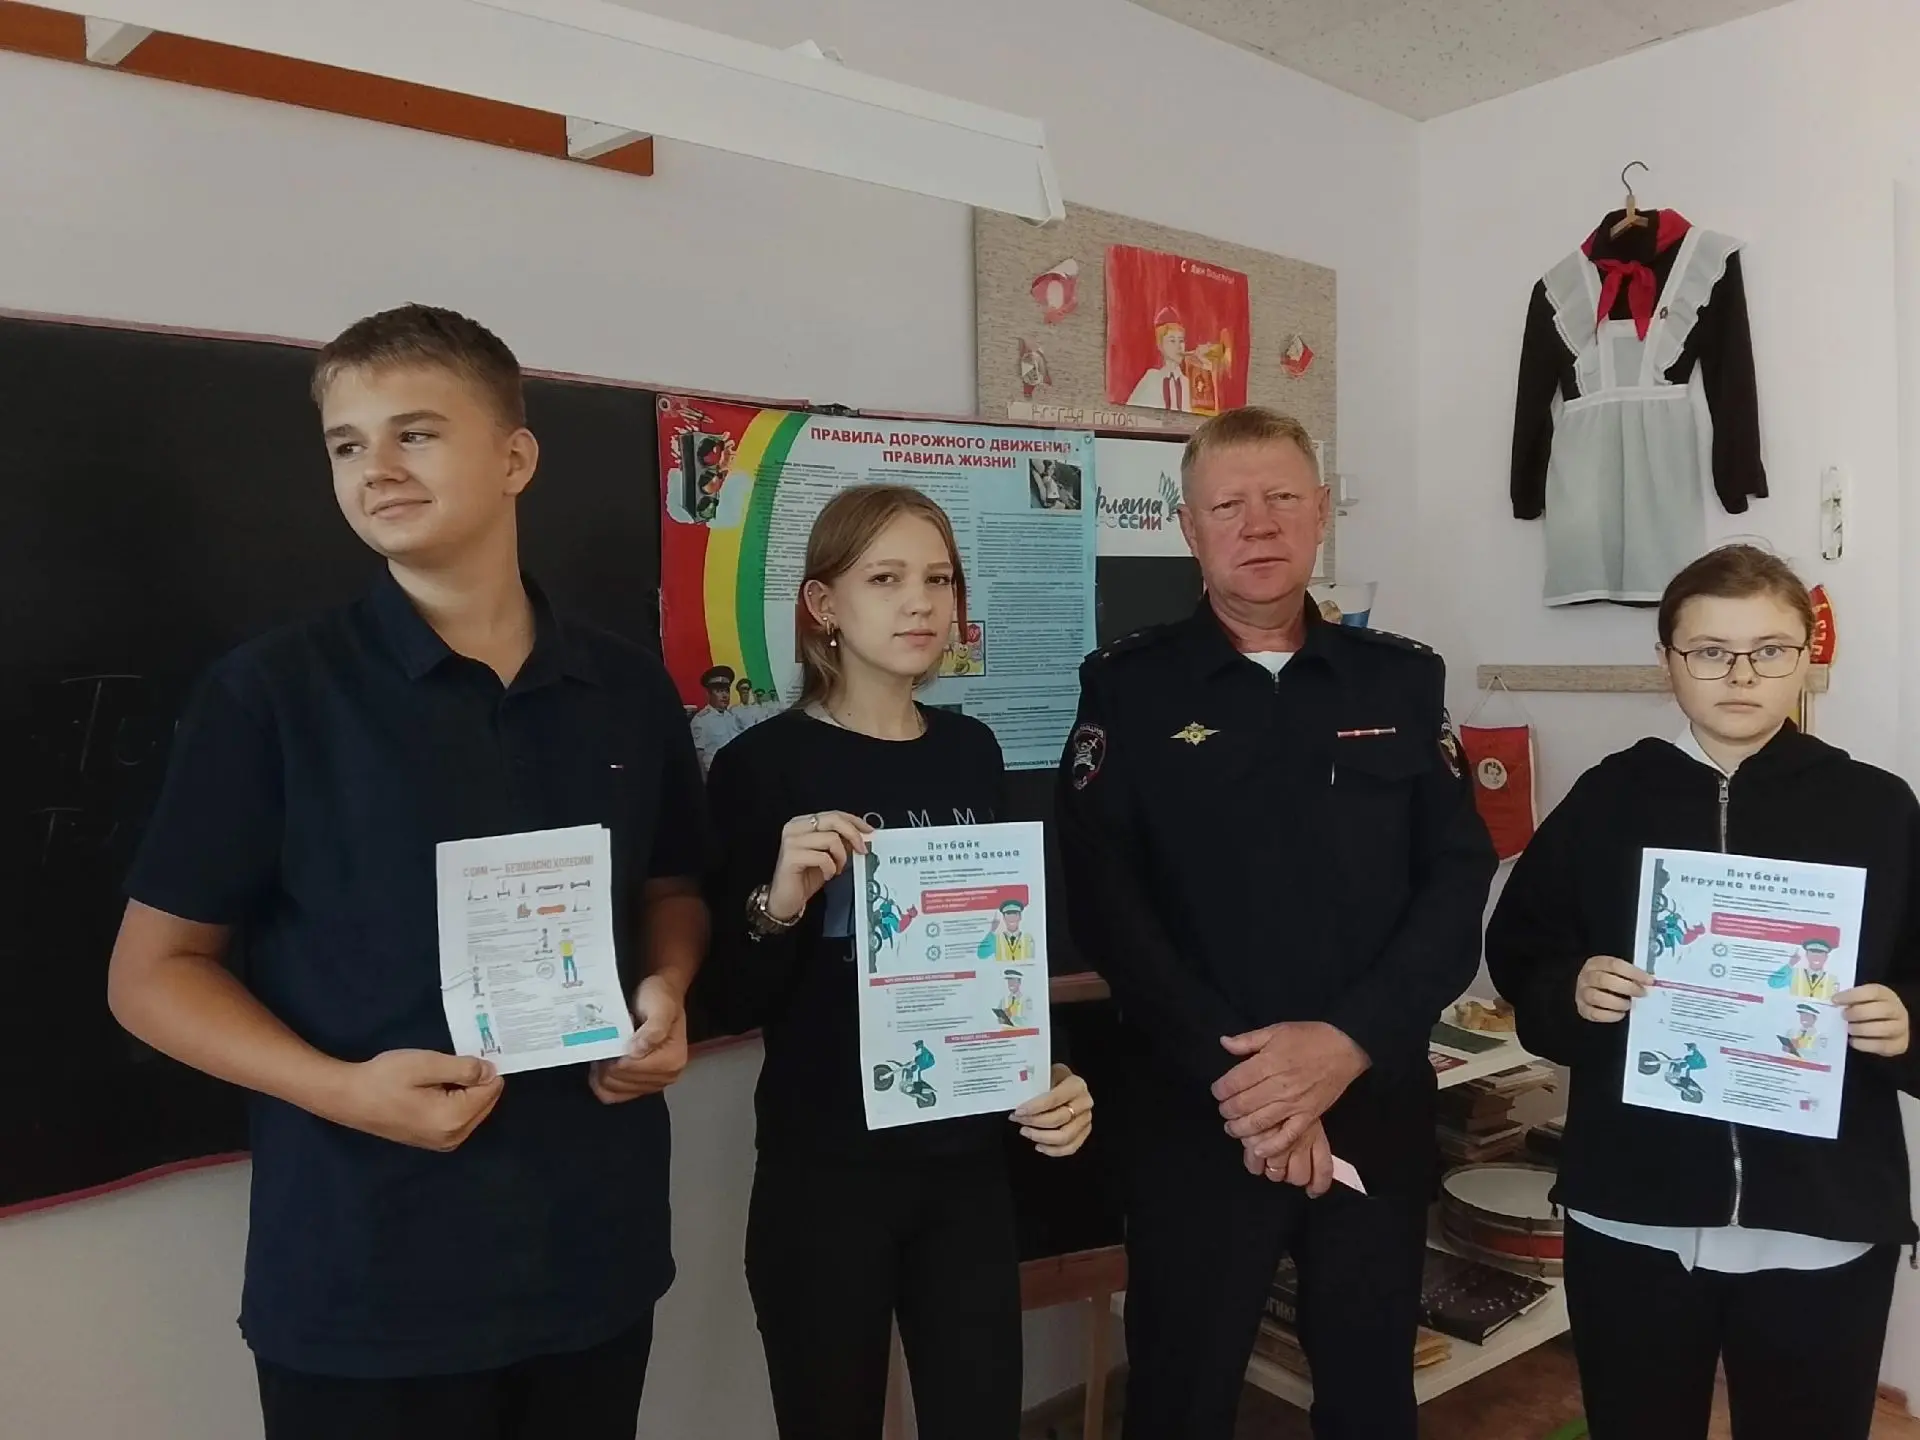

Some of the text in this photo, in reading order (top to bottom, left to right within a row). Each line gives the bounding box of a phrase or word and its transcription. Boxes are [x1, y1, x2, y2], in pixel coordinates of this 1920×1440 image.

[811, 427, 884, 445] ПРАВИЛА
[889, 432, 986, 450] ДОРОЖНОГО
[883, 450, 1017, 469] ПРАВИЛА ЖИЗНИ!
[927, 840, 981, 852] Питбайк
[889, 853, 943, 865] Игрушка
[974, 849, 1021, 860] закона
[1727, 868, 1790, 883] Питбайк
[1680, 874, 1744, 889] Игрушка
[1780, 886, 1836, 900] закона
